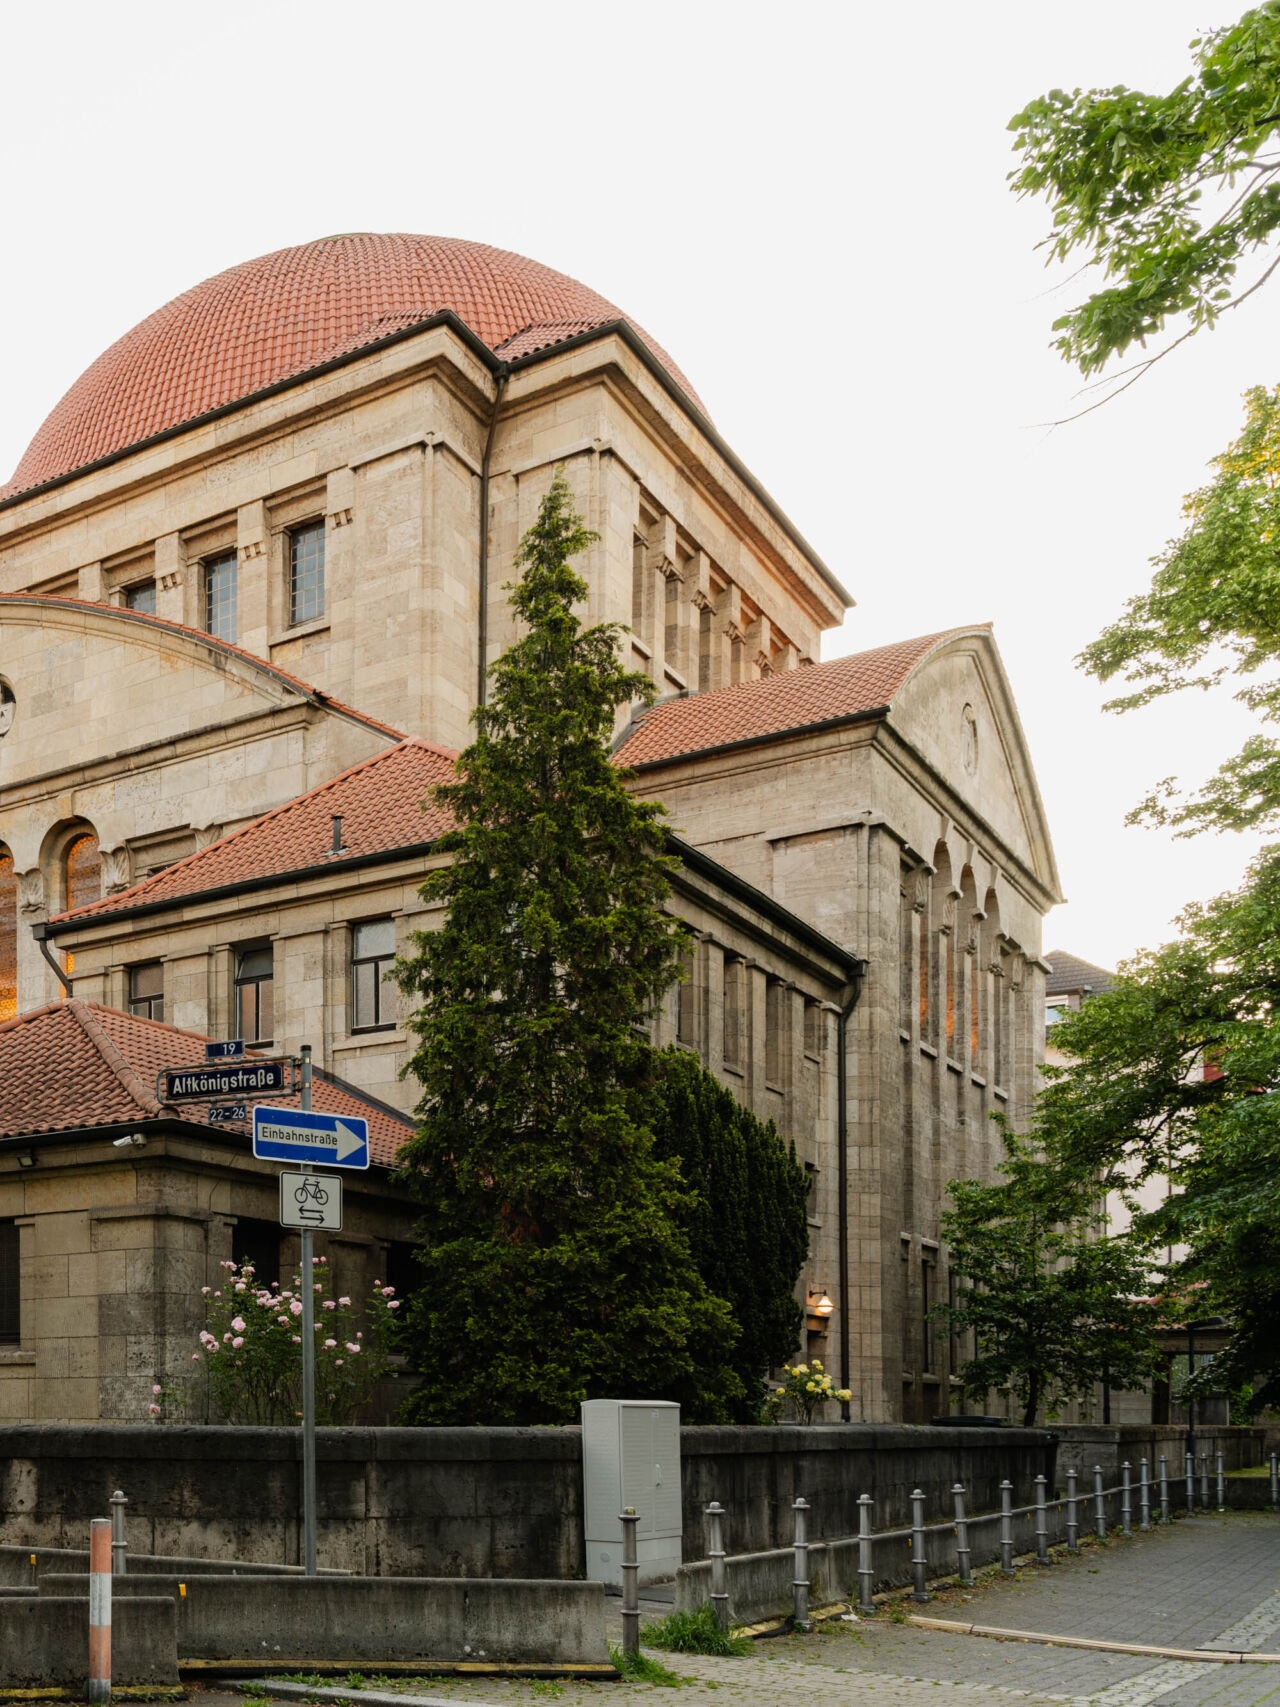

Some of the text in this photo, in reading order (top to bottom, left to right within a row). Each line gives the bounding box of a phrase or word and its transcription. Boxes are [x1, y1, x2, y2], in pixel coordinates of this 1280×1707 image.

[223, 1043, 236, 1055] 19
[173, 1069, 274, 1094] Altkönigstraße
[262, 1126, 338, 1146] Einbahnstraße
